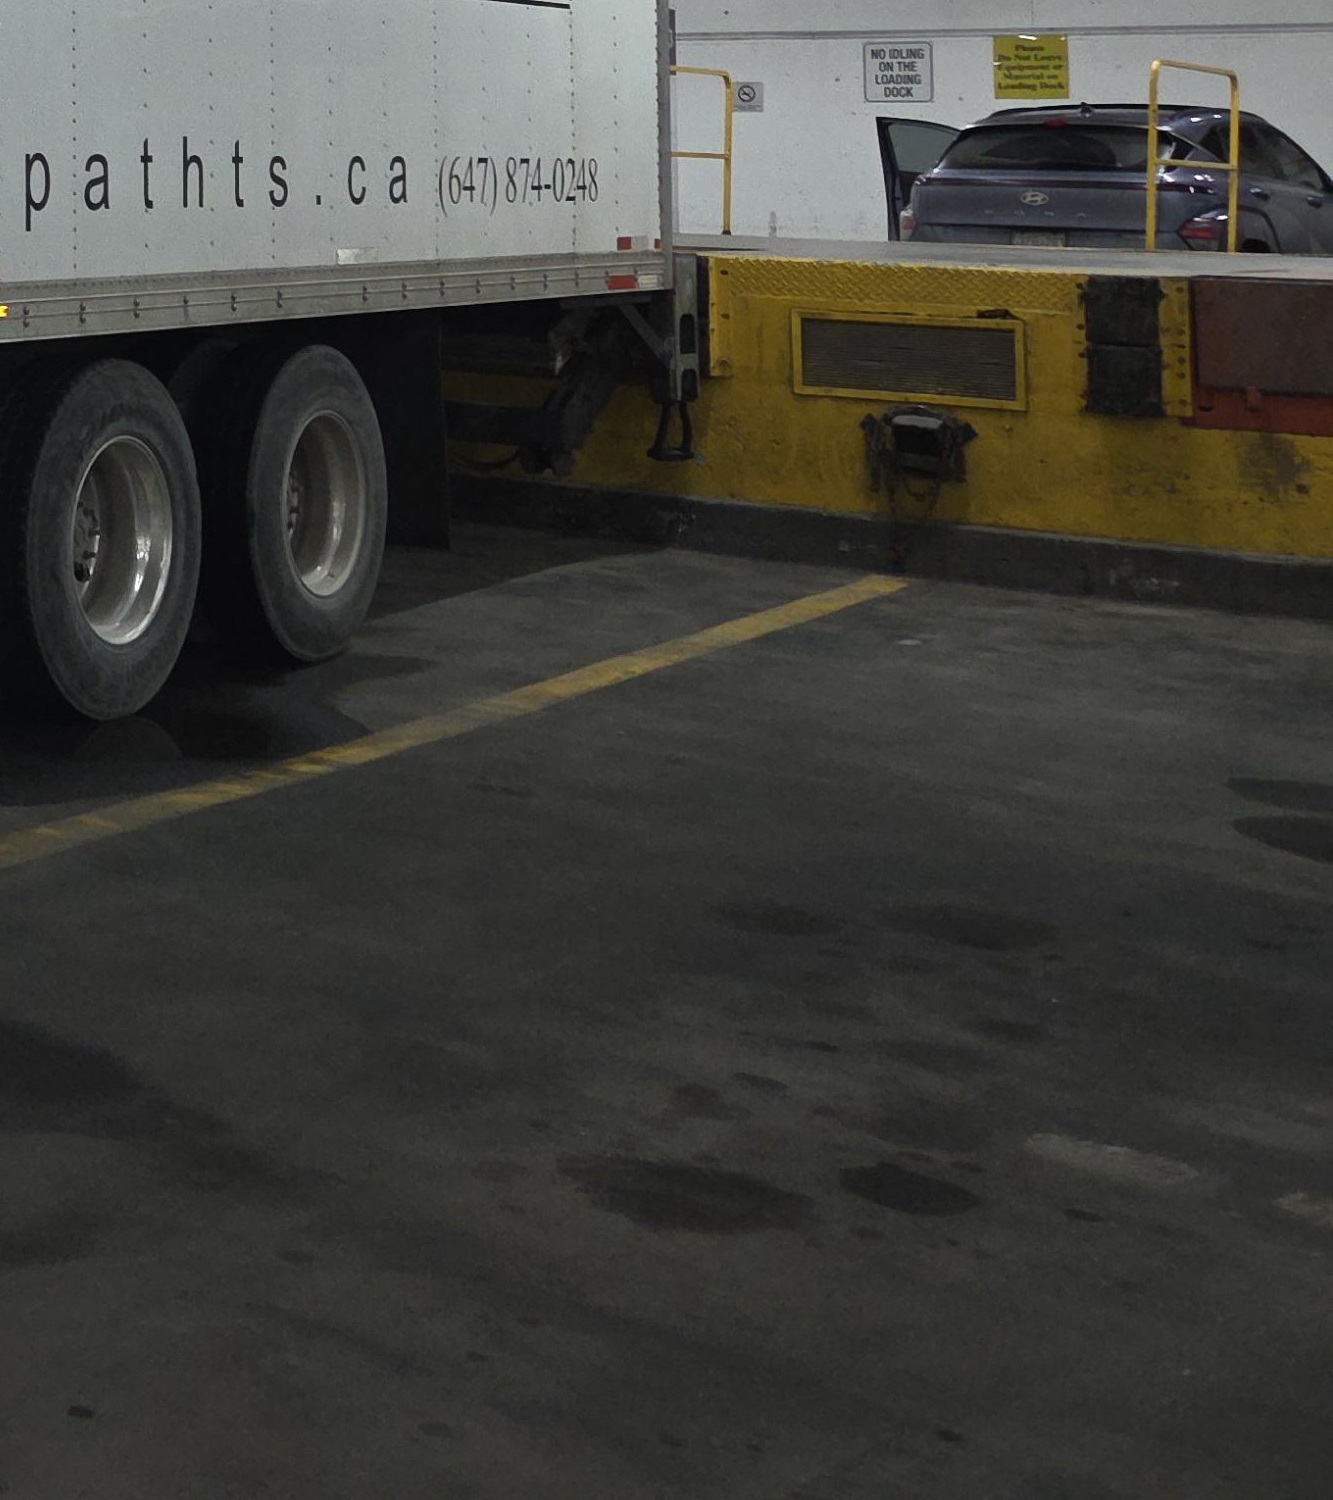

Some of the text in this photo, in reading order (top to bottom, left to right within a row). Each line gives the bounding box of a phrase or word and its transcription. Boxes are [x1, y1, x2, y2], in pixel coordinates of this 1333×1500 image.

[870, 48, 925, 60] NO IDLING
[879, 61, 917, 72] ON THE
[875, 73, 922, 85] LOADING
[884, 86, 914, 98] DOCK
[438, 155, 599, 218] (647) 874-0248
